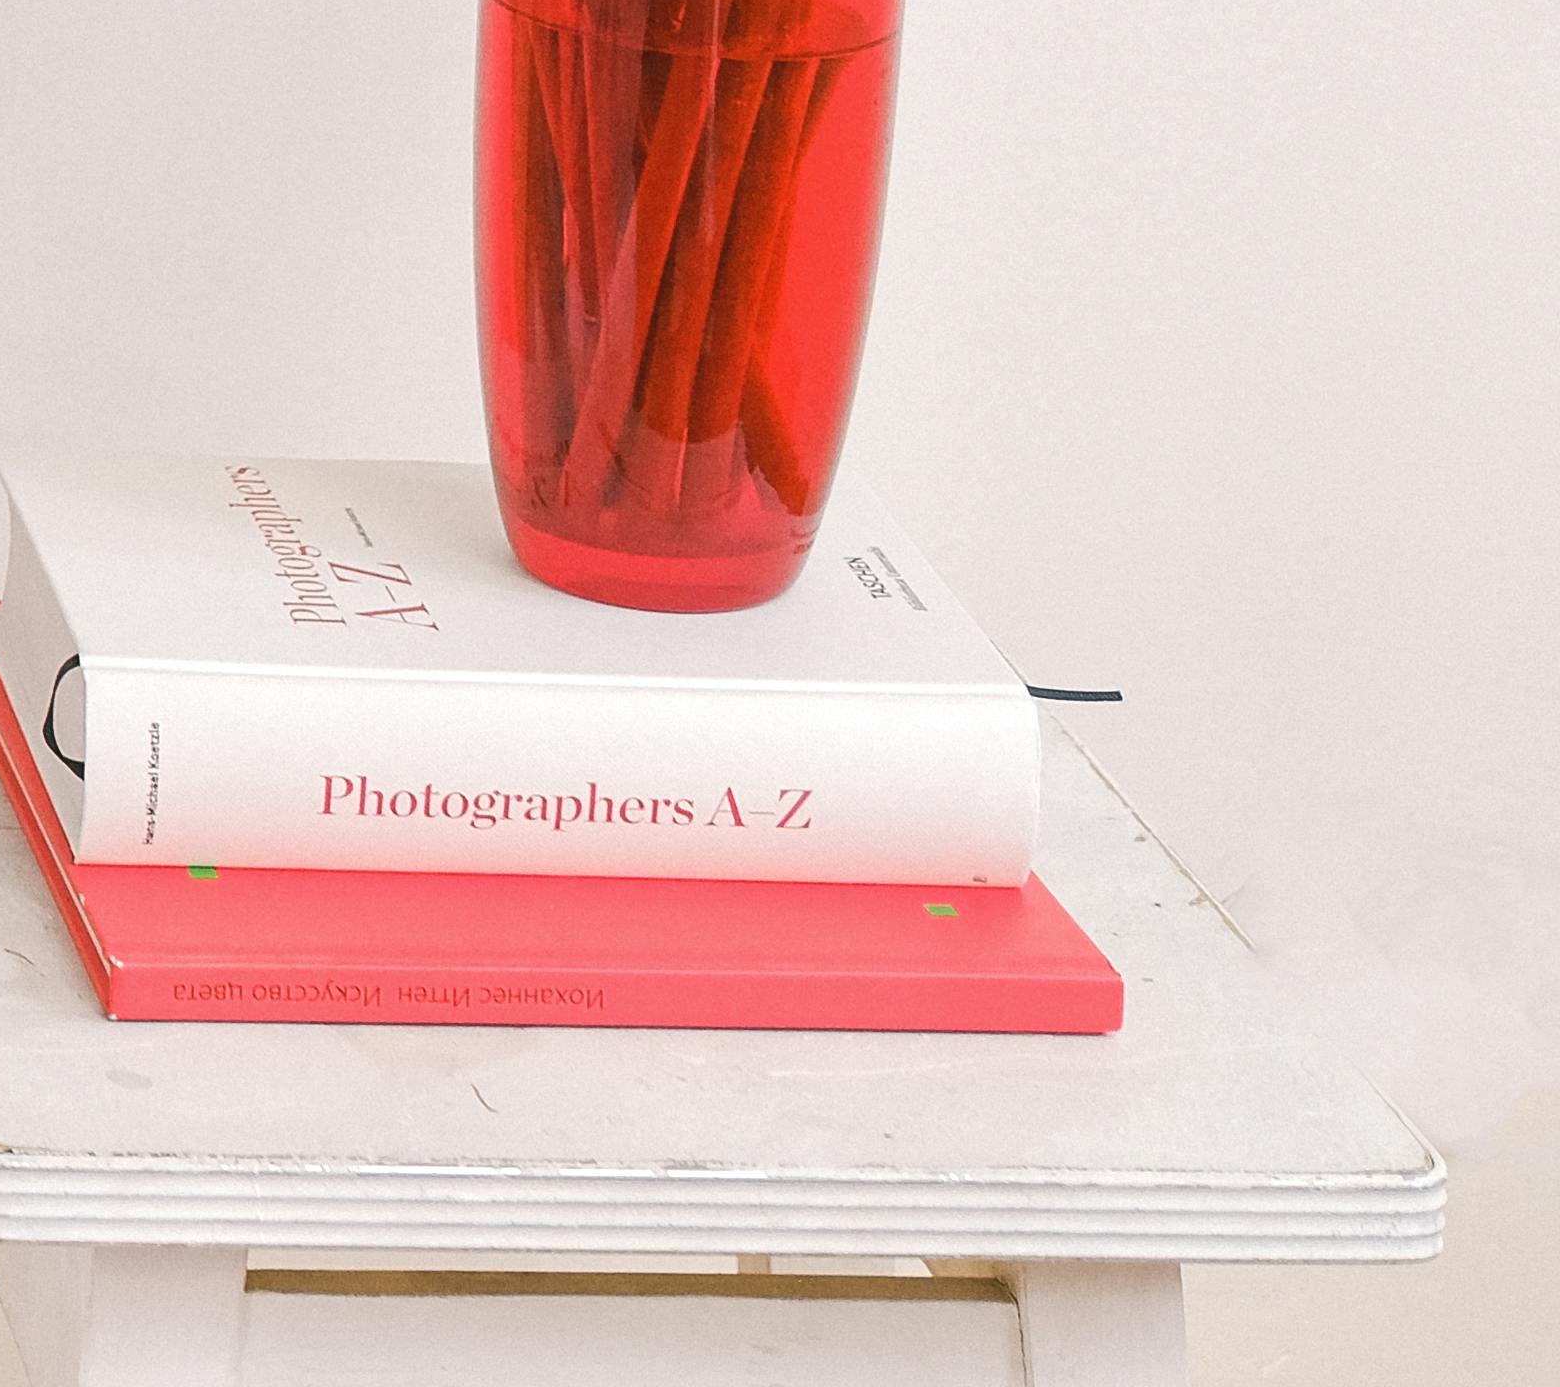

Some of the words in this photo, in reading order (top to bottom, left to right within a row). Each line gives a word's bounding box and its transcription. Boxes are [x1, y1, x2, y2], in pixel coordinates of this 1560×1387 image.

[225, 466, 347, 626] Photographers
[843, 557, 892, 599] TASCHEN
[148, 722, 160, 769] Koetzle
[316, 774, 695, 832] Photographers
[173, 982, 243, 1001] цвета
[252, 979, 380, 1007] Искусство
[398, 985, 470, 1009] Иттен
[480, 986, 605, 1010] Иоханнес
